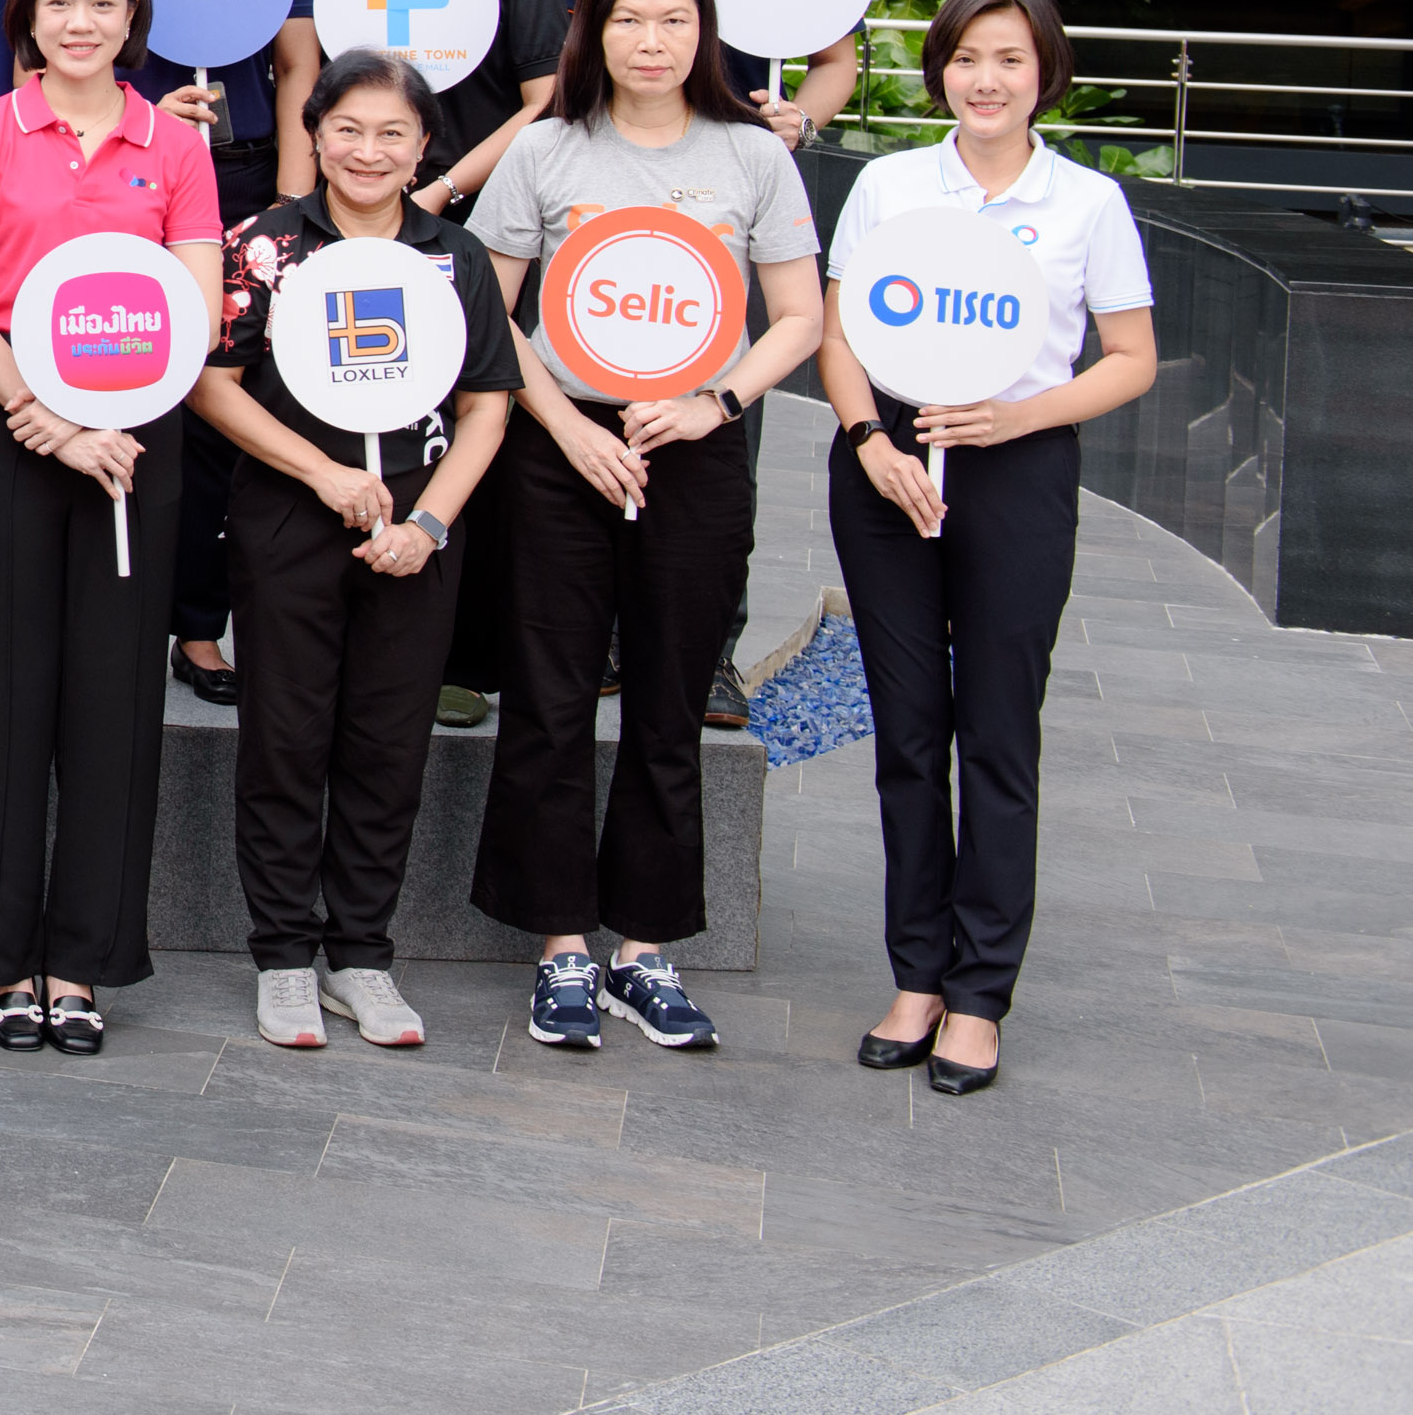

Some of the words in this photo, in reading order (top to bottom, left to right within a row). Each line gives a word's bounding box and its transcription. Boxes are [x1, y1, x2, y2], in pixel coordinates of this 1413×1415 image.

[423, 49, 467, 60] TOWN
[587, 278, 701, 328] Selic
[934, 287, 1021, 330] TISCO
[59, 304, 162, 336] เมืองไทย
[331, 365, 409, 384] LOXLEY
